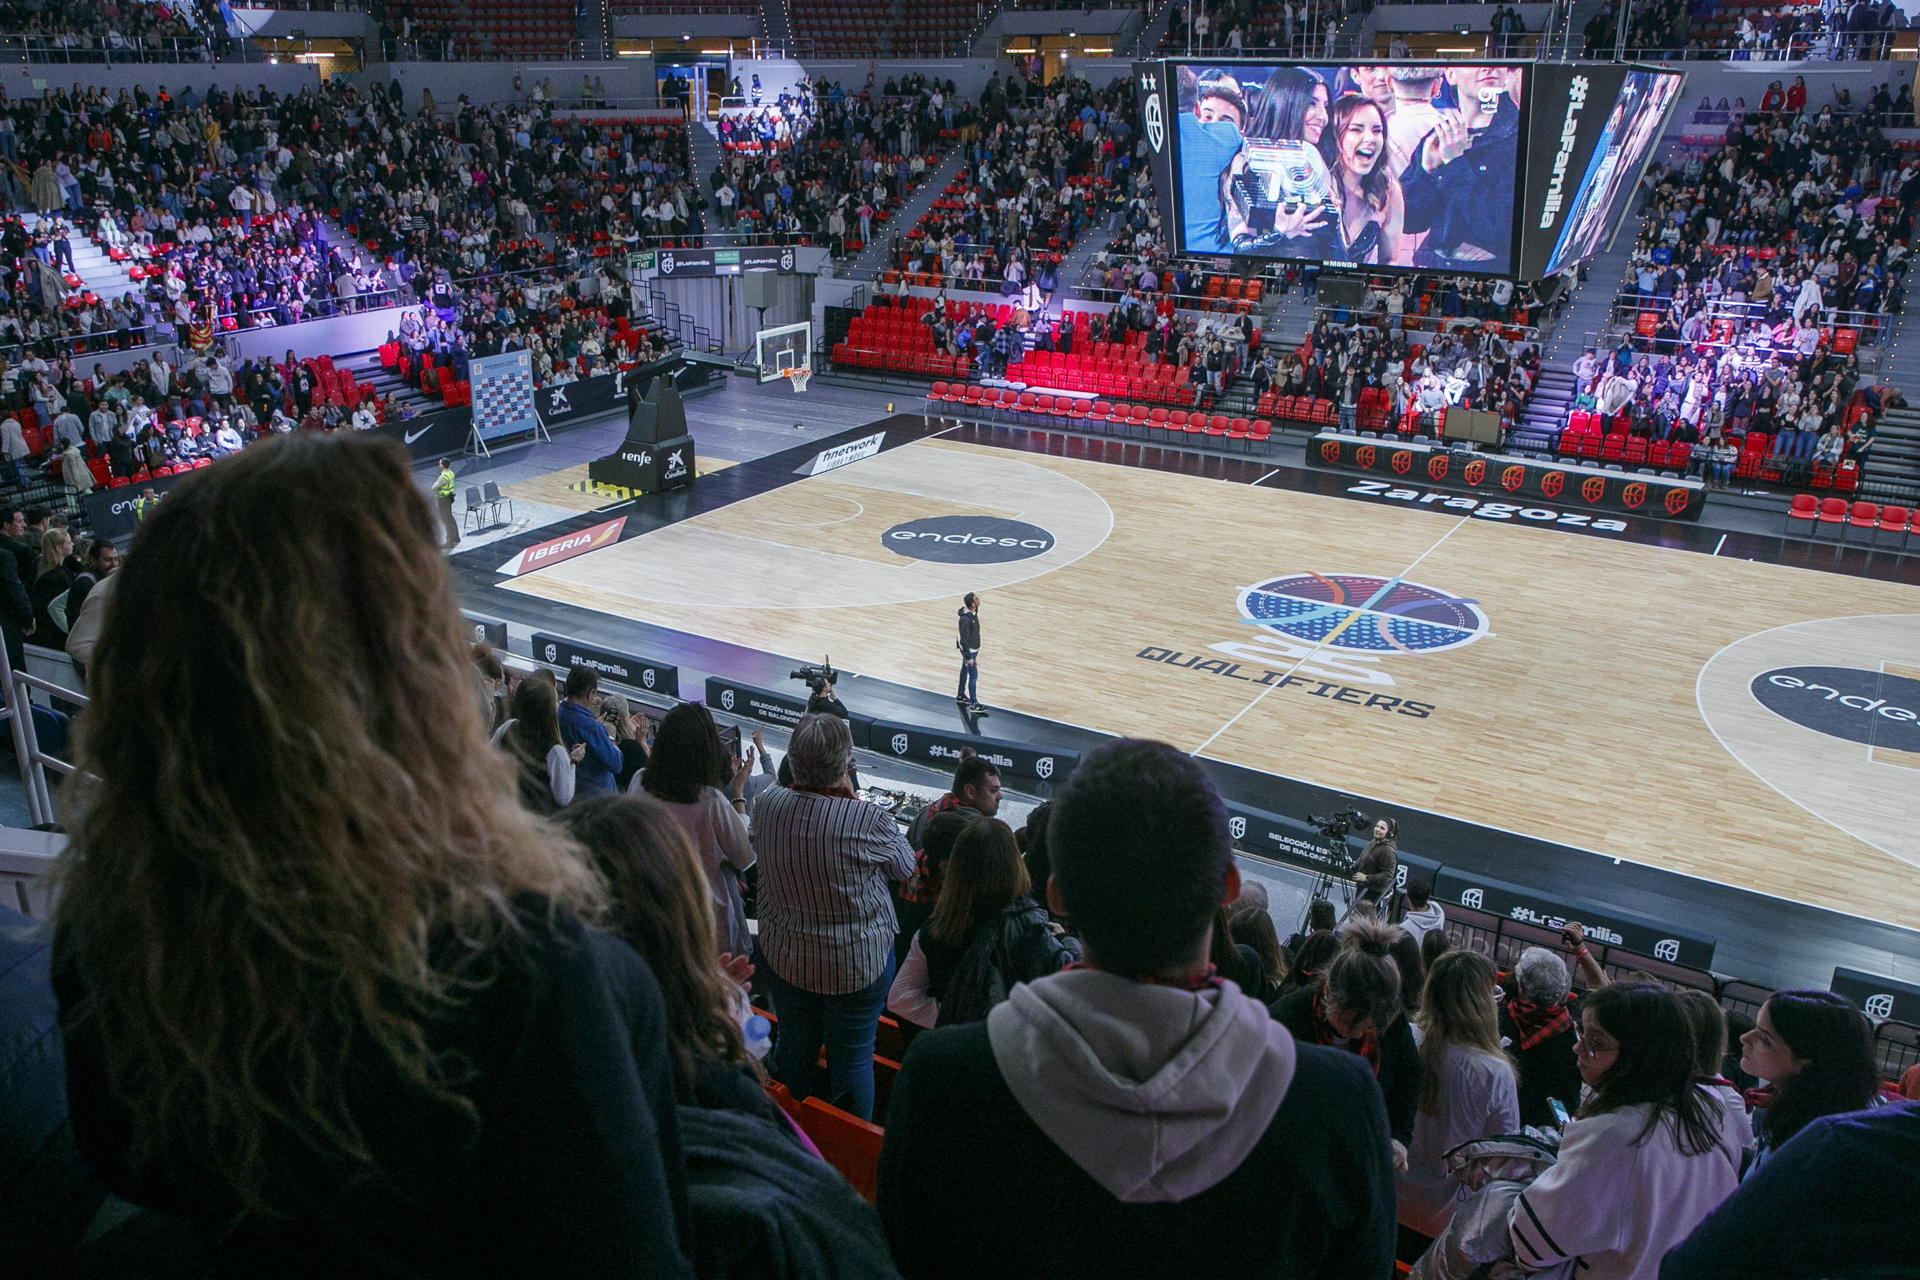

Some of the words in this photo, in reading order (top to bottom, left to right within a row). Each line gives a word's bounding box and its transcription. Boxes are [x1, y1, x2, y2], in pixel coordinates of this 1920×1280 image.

[1540, 75, 1588, 229] #LaFamilia
[1330, 260, 1358, 269] MONDO
[822, 435, 879, 462] finetwork
[1347, 480, 1628, 532] Zaragoza
[528, 533, 592, 562] IBERIA
[891, 531, 1048, 549] endesa
[571, 654, 628, 678] #LaFamilia
[1135, 646, 1436, 719] QUALIFIERS
[1768, 675, 1920, 726] ende
[929, 744, 1013, 768] #Lamilia
[1268, 832, 1315, 851] SELECCIÓN
[1279, 843, 1291, 852] DE
